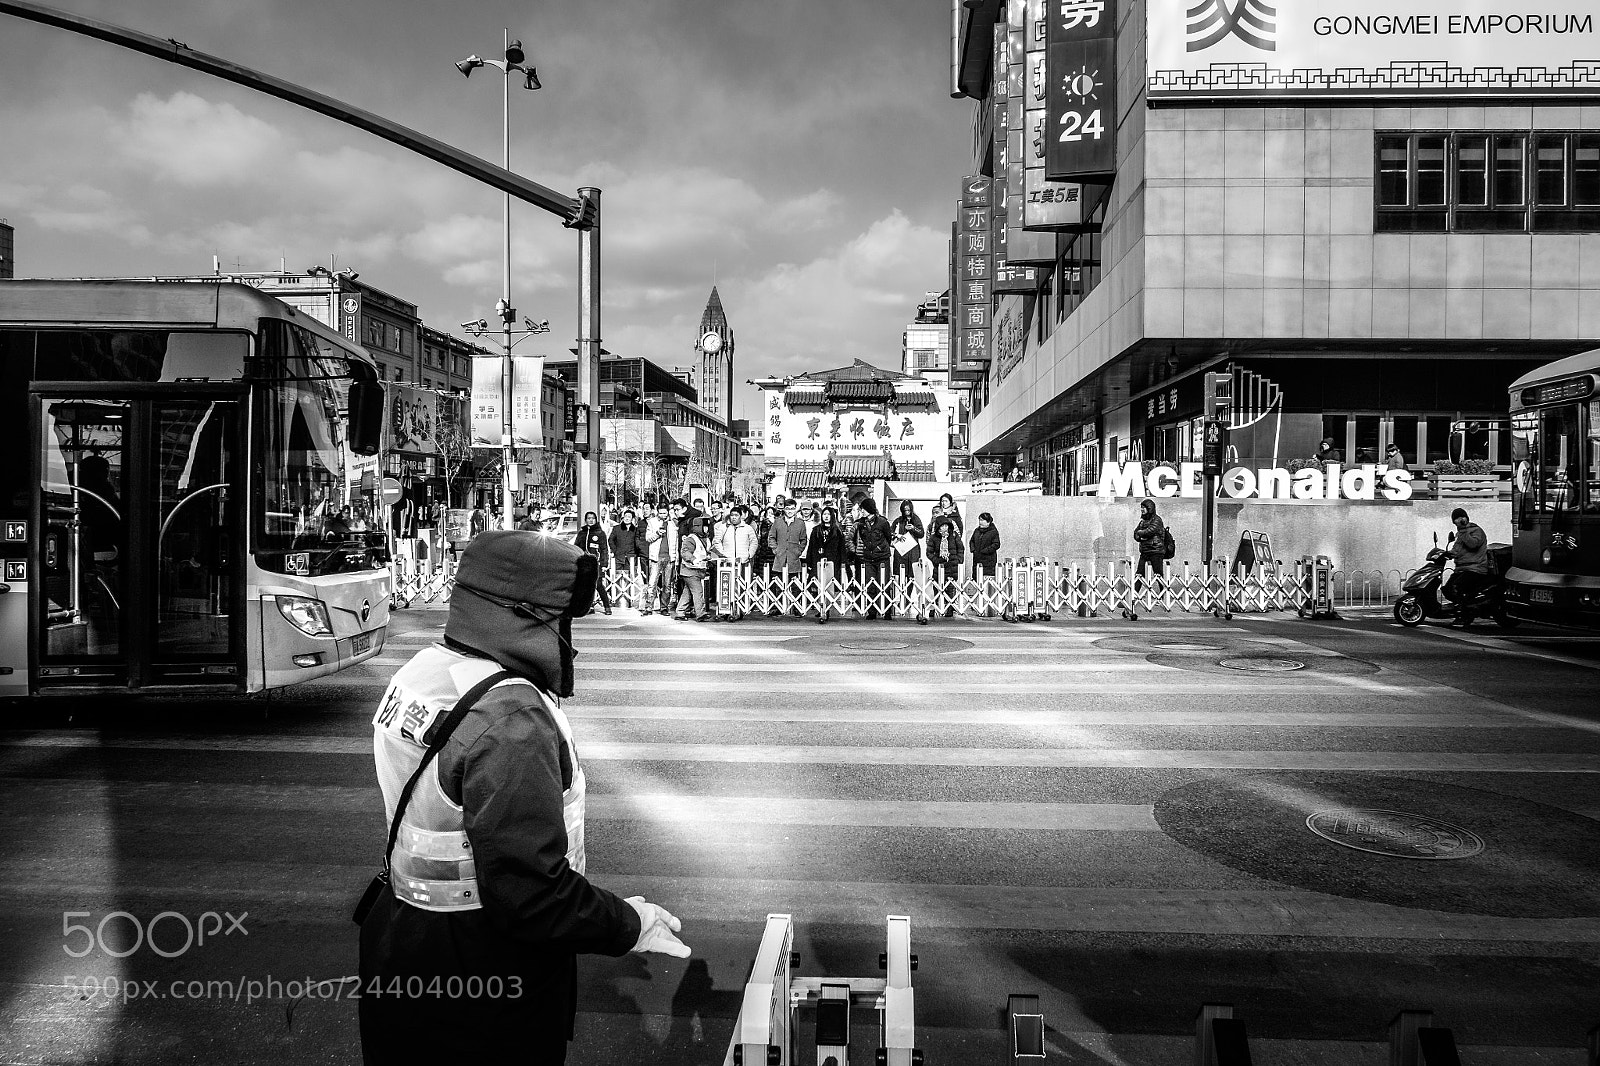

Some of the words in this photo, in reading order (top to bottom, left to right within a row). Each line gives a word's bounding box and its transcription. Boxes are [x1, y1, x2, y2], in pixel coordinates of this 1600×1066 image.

[1313, 15, 1439, 36] GONGMEI
[1448, 14, 1593, 34] EMPORIUM
[1059, 109, 1105, 143] 24
[1027, 187, 1079, 204] 工美5层
[967, 209, 986, 349] 亦购特惠商城
[1147, 388, 1178, 419] 麦当劳
